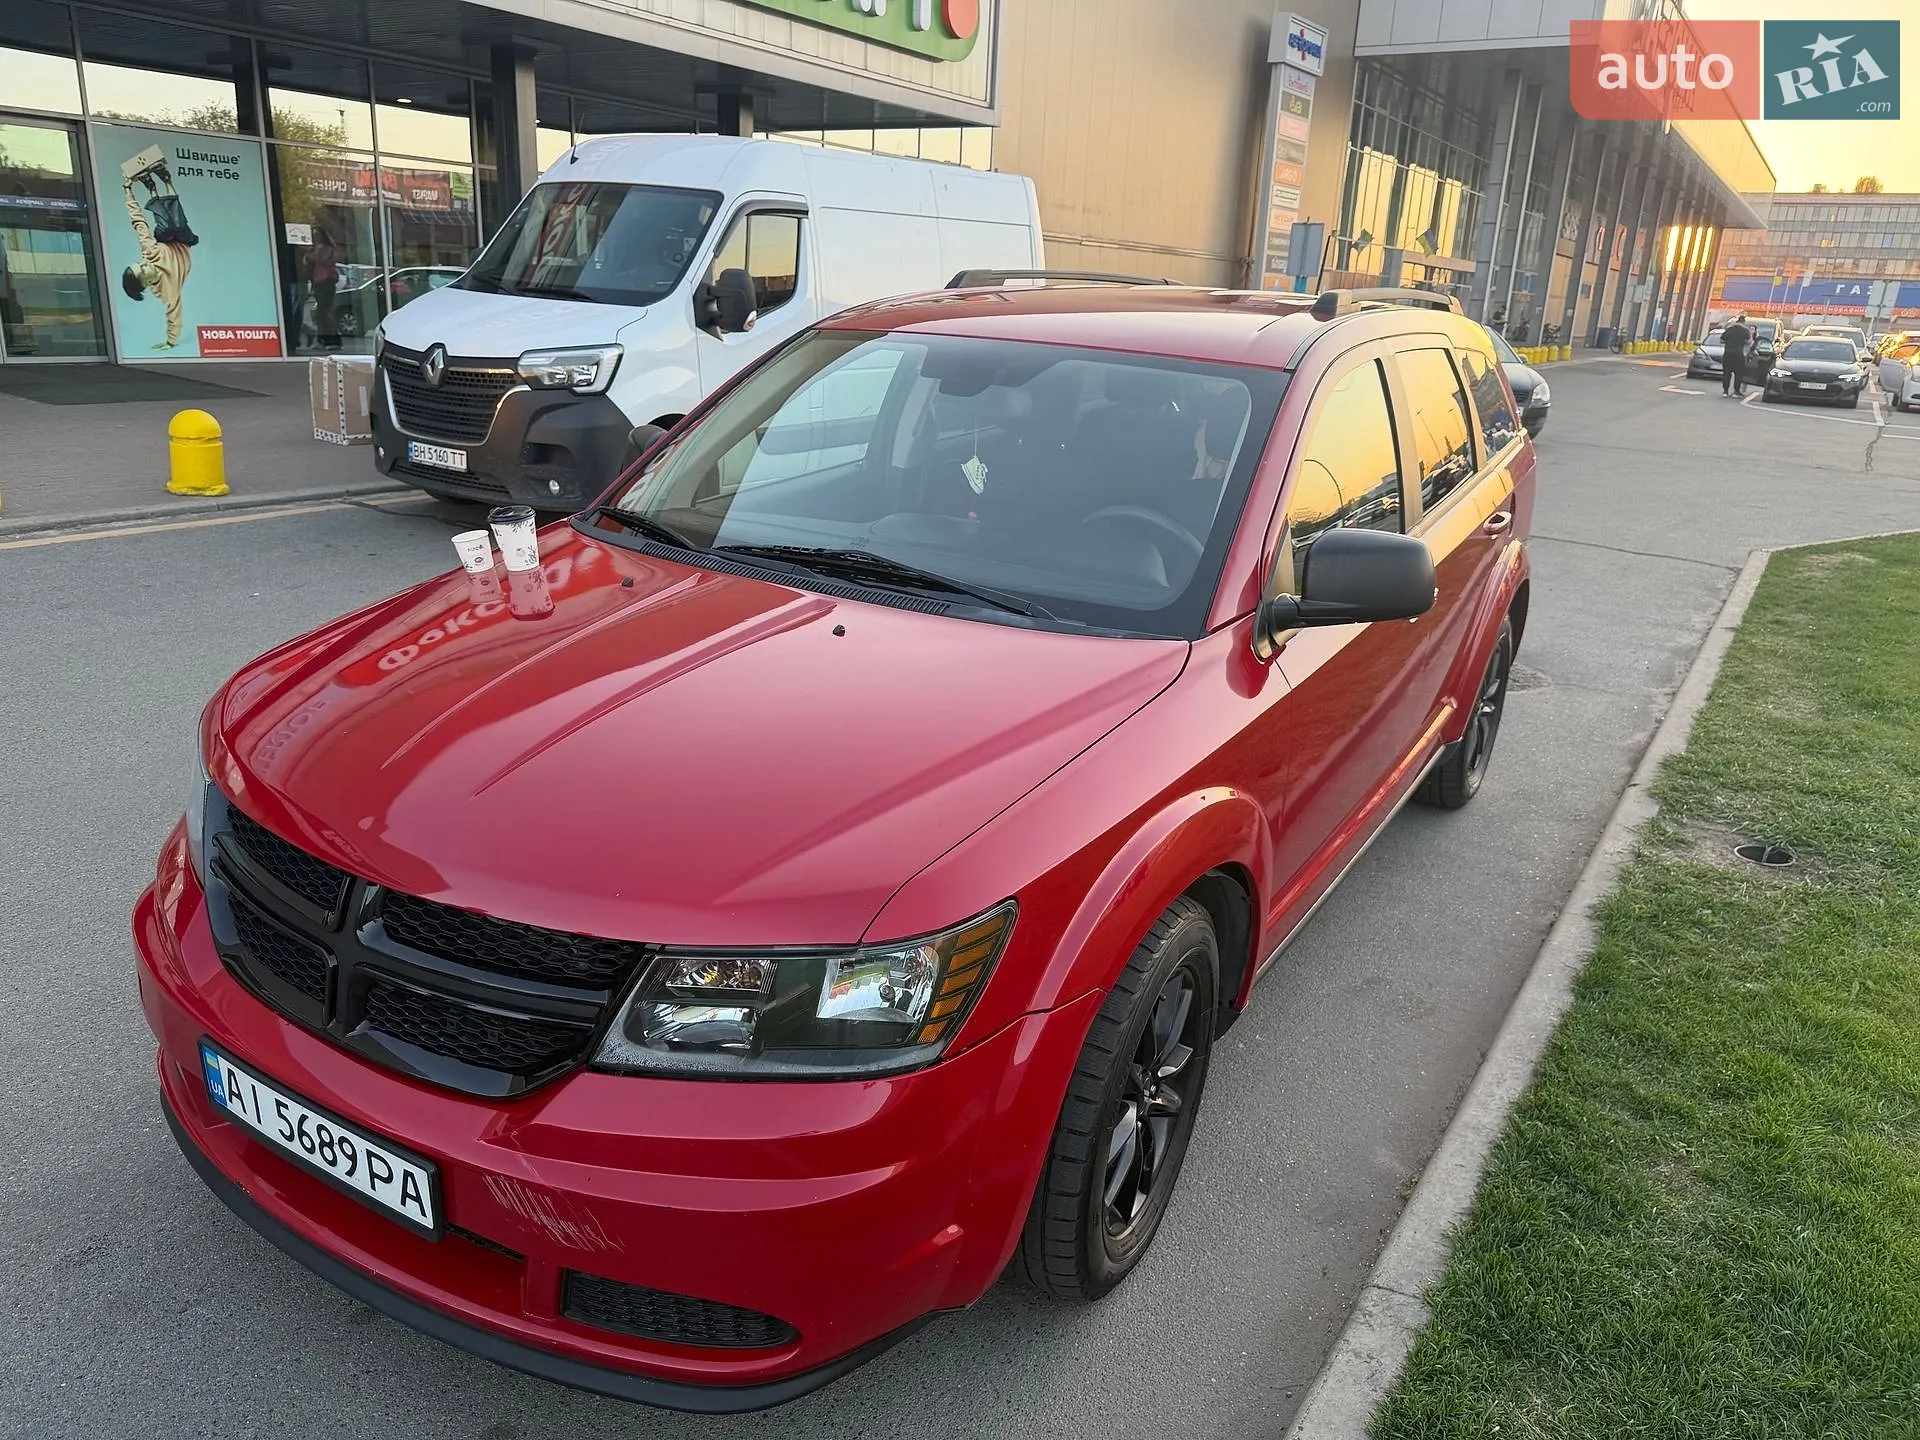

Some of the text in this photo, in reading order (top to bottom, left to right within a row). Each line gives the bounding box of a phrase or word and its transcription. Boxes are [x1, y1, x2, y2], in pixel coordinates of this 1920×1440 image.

[178, 166, 240, 181] для тебе
[201, 329, 278, 340] НОВА ПОШТА
[210, 1079, 225, 1099] UA
[226, 1067, 428, 1218] AI 5689 PA
